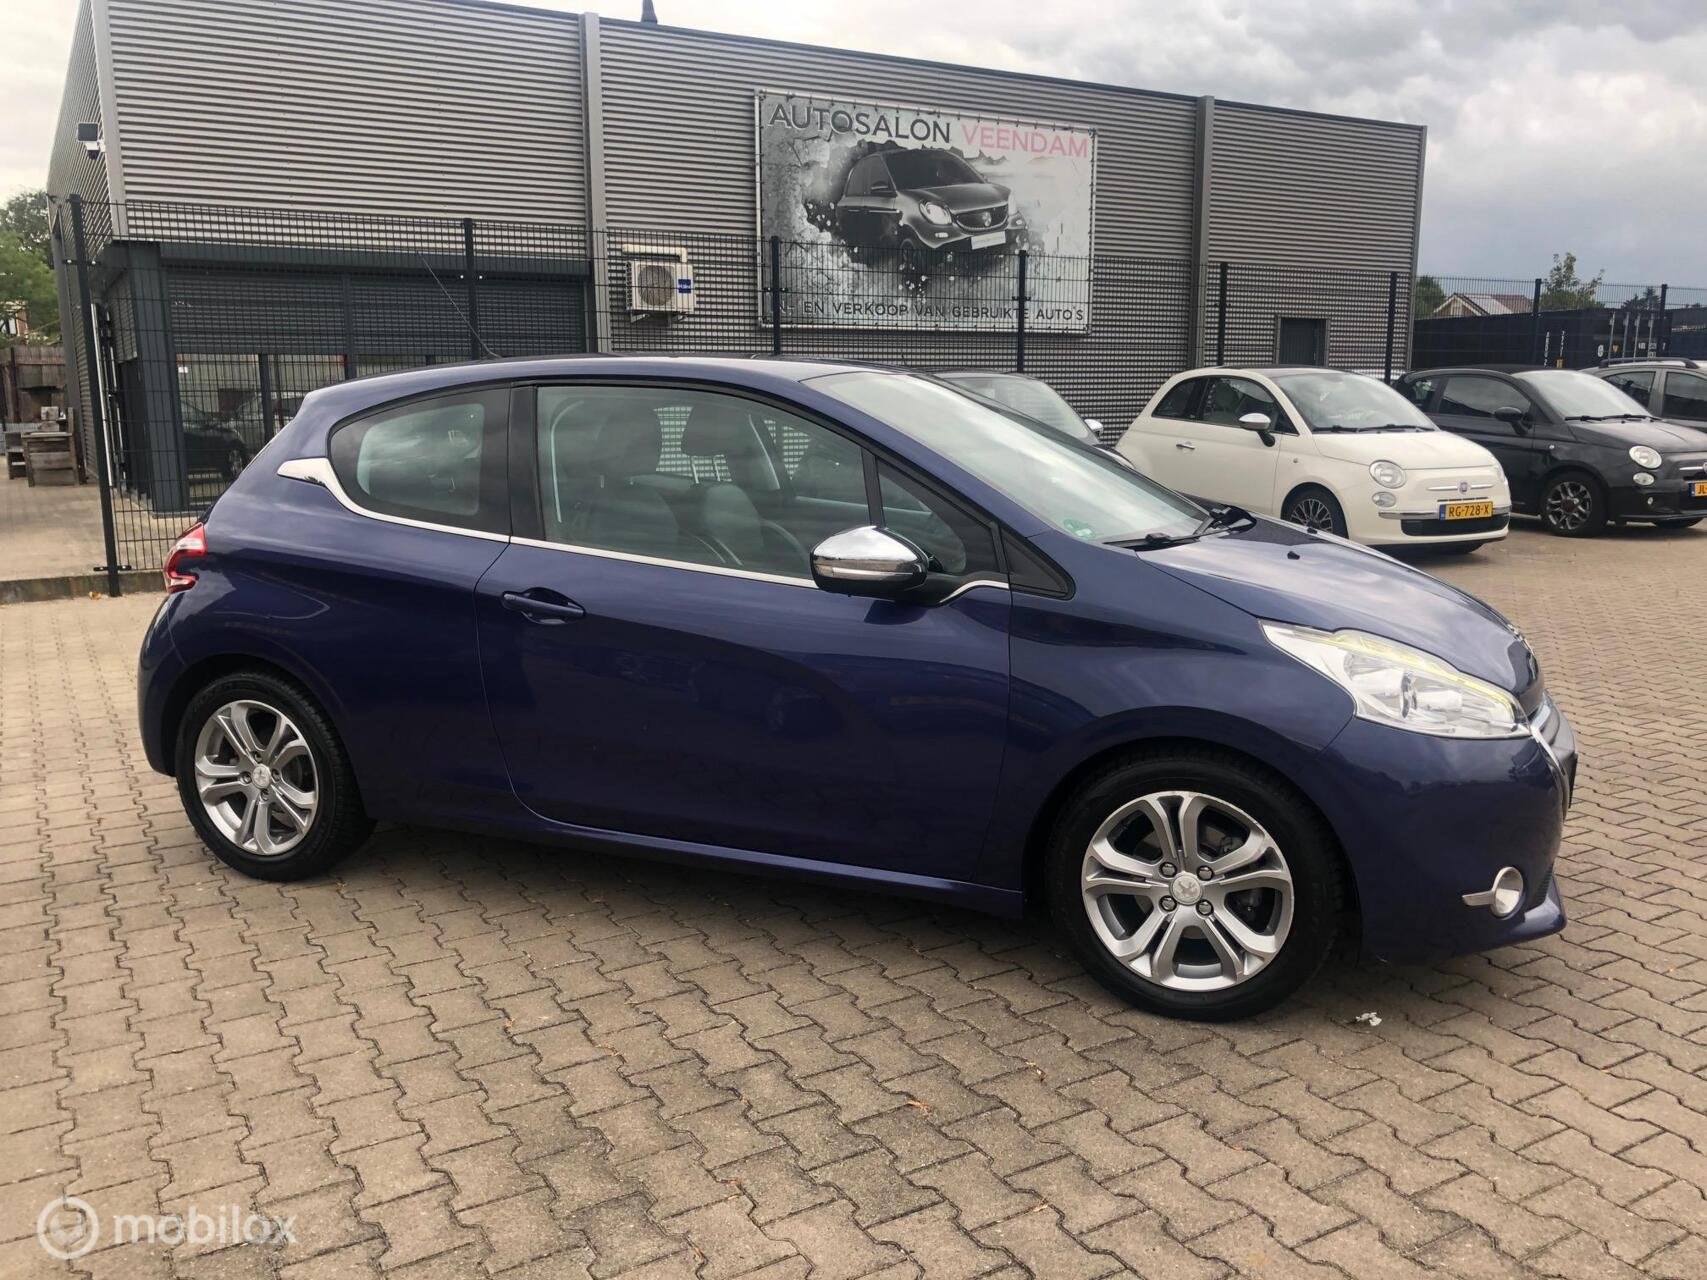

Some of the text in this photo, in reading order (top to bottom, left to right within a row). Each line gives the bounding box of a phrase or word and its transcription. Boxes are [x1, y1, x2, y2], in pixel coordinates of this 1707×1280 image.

[768, 103, 1089, 158] AUTOSALON VEENDAM
[804, 301, 825, 314] EN
[832, 302, 908, 316] VERKOOP
[914, 304, 944, 317] VAN
[1036, 308, 1084, 321] AUTO'S
[1448, 504, 1489, 518] RG-728-X
